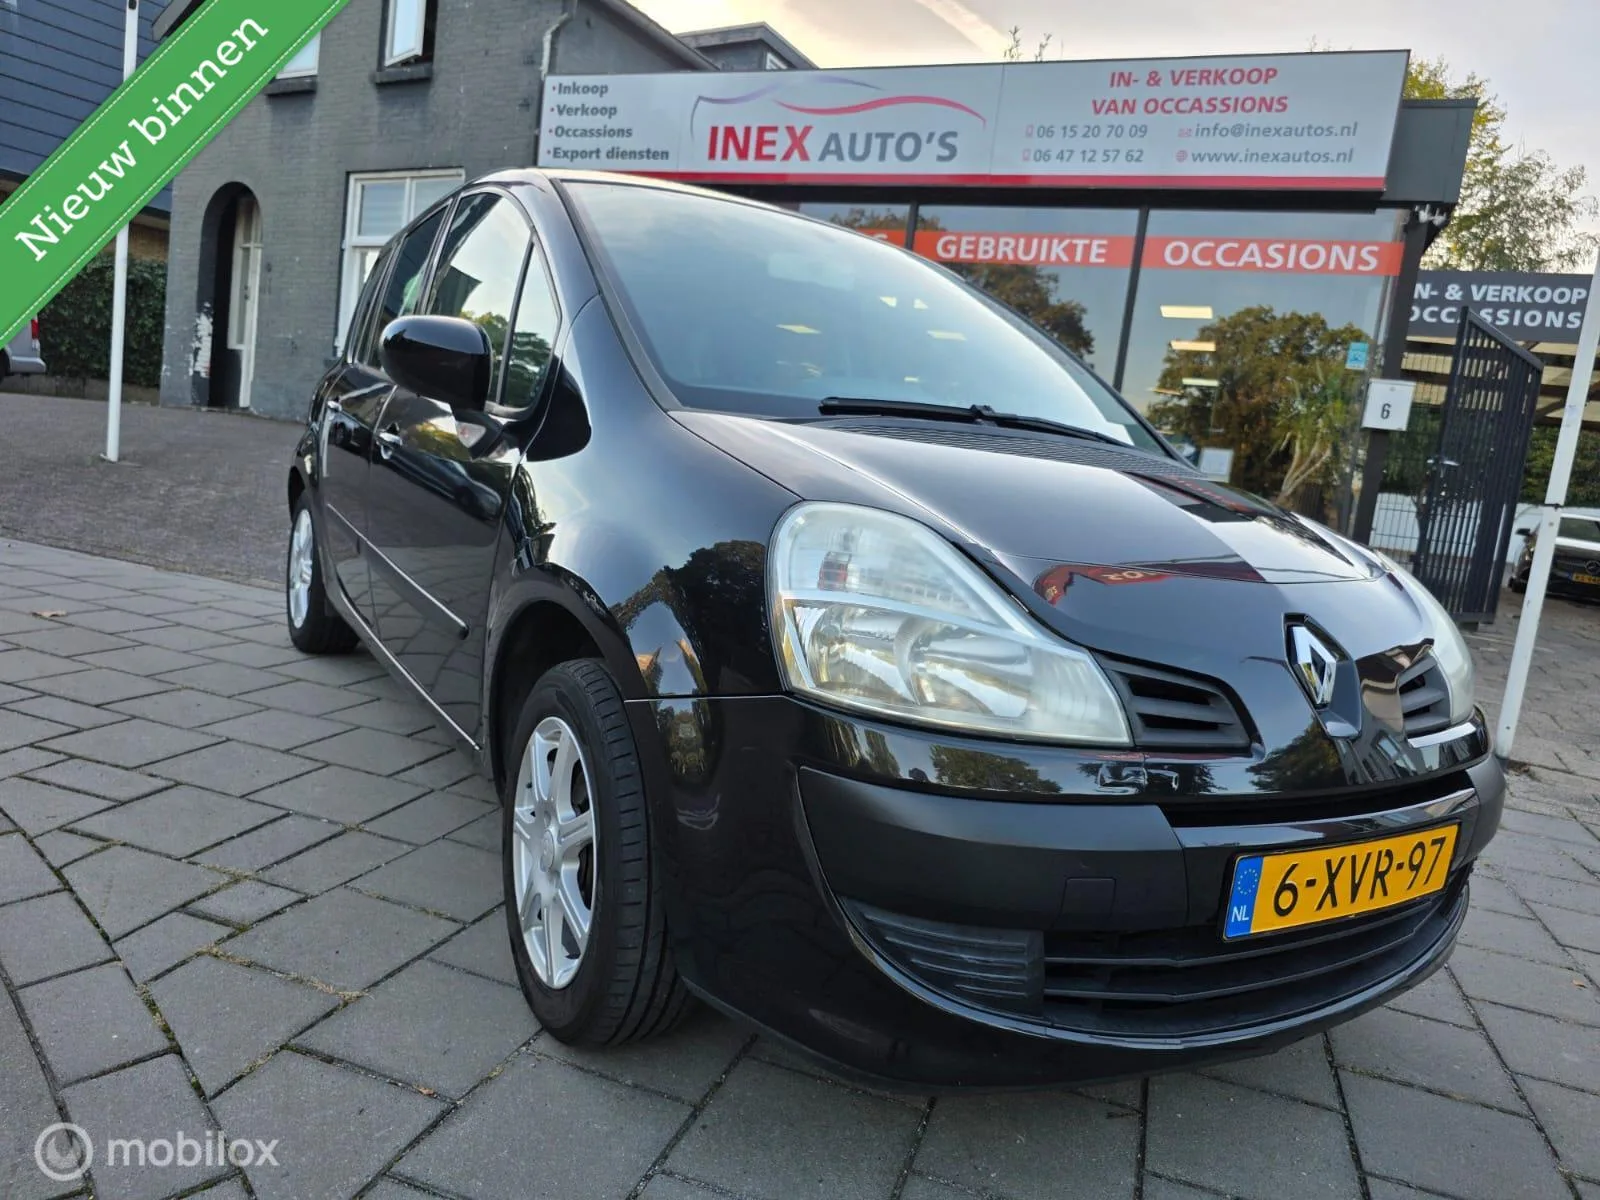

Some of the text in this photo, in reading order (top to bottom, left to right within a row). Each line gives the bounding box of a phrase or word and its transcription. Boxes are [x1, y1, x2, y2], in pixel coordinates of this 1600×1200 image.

[1109, 68, 1278, 88] IN- & VERKOOP
[557, 82, 609, 98] Inkoop
[556, 104, 618, 119] Verkoop
[1092, 96, 1289, 115] VAN OCCASSIONS
[554, 124, 634, 139] Occassions
[1036, 124, 1148, 139] 06 15 20 70 09
[1194, 122, 1358, 138] info@inexautos.nl
[707, 126, 814, 162] INEX
[552, 146, 669, 162] Export diensten
[1033, 149, 1144, 163] 06 47 12 57 62
[1191, 149, 1354, 164] www.inexautos.nl
[936, 234, 1107, 263] GEBRUIKTE
[1163, 241, 1379, 271] OCCASIONS
[1413, 283, 1587, 305] N- & VERKOOP
[1409, 305, 1582, 329] CCSSIONS
[1380, 402, 1391, 420] 6
[1231, 836, 1447, 923] NL 6-XVR-97
